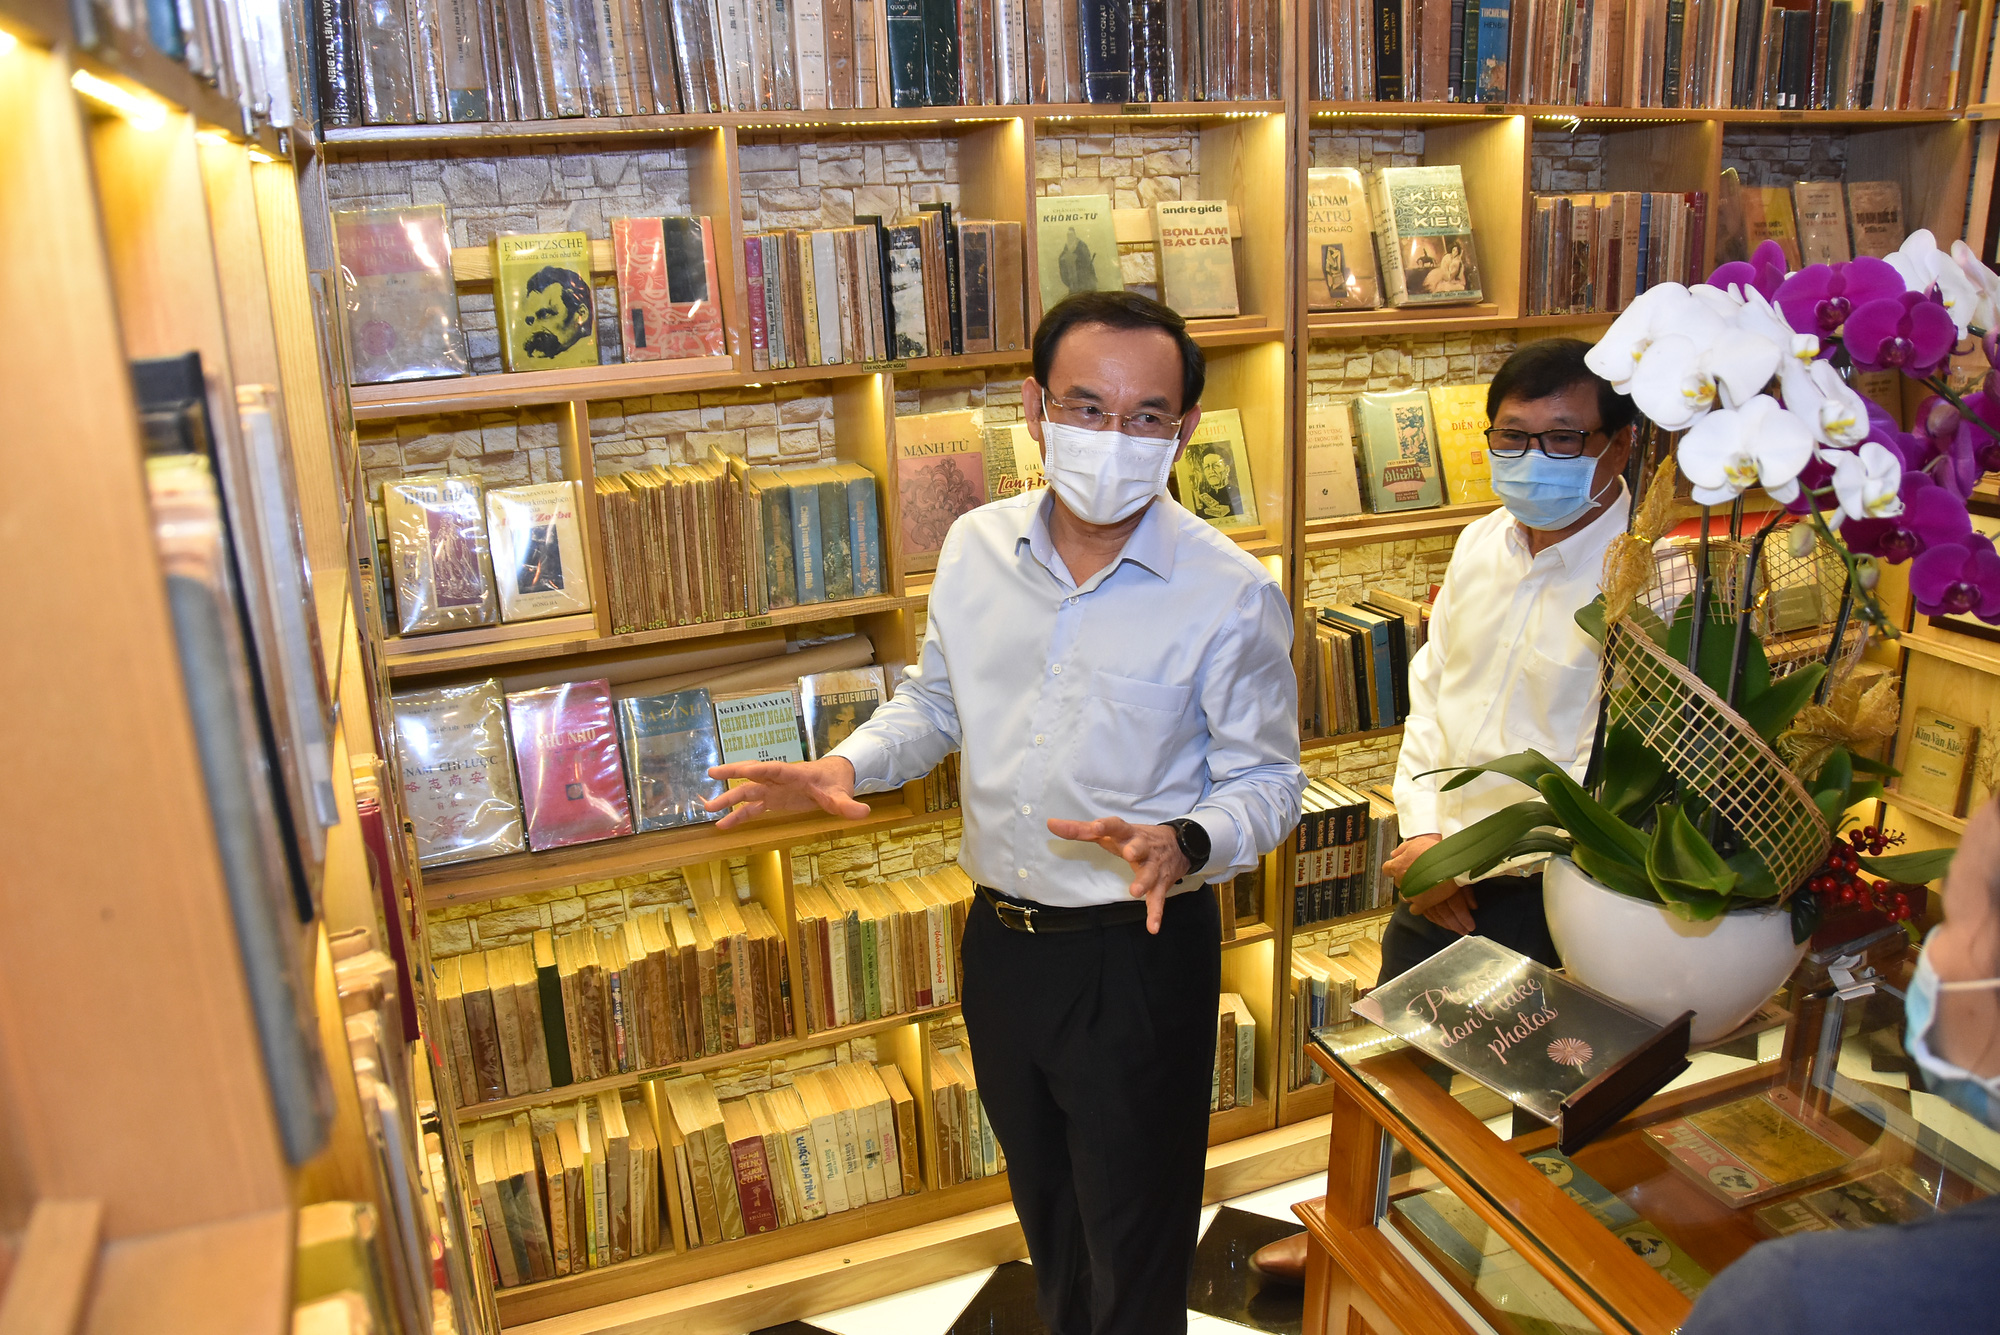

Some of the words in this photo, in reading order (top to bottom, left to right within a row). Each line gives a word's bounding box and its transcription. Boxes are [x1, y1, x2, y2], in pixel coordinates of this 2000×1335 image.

[1197, 204, 1223, 215] gide
[514, 238, 584, 252] NIETZSCHE
[821, 694, 838, 706] CHE
[838, 690, 878, 705] GUEVARA
[720, 714, 748, 734] CHINH
[749, 712, 766, 732] PHỤ
[1406, 963, 1502, 1026] Please
[1439, 1001, 1495, 1048] don't
[1493, 977, 1542, 1014] take
[1487, 1005, 1558, 1064] photos
[796, 1136, 811, 1165] KHÁCH
